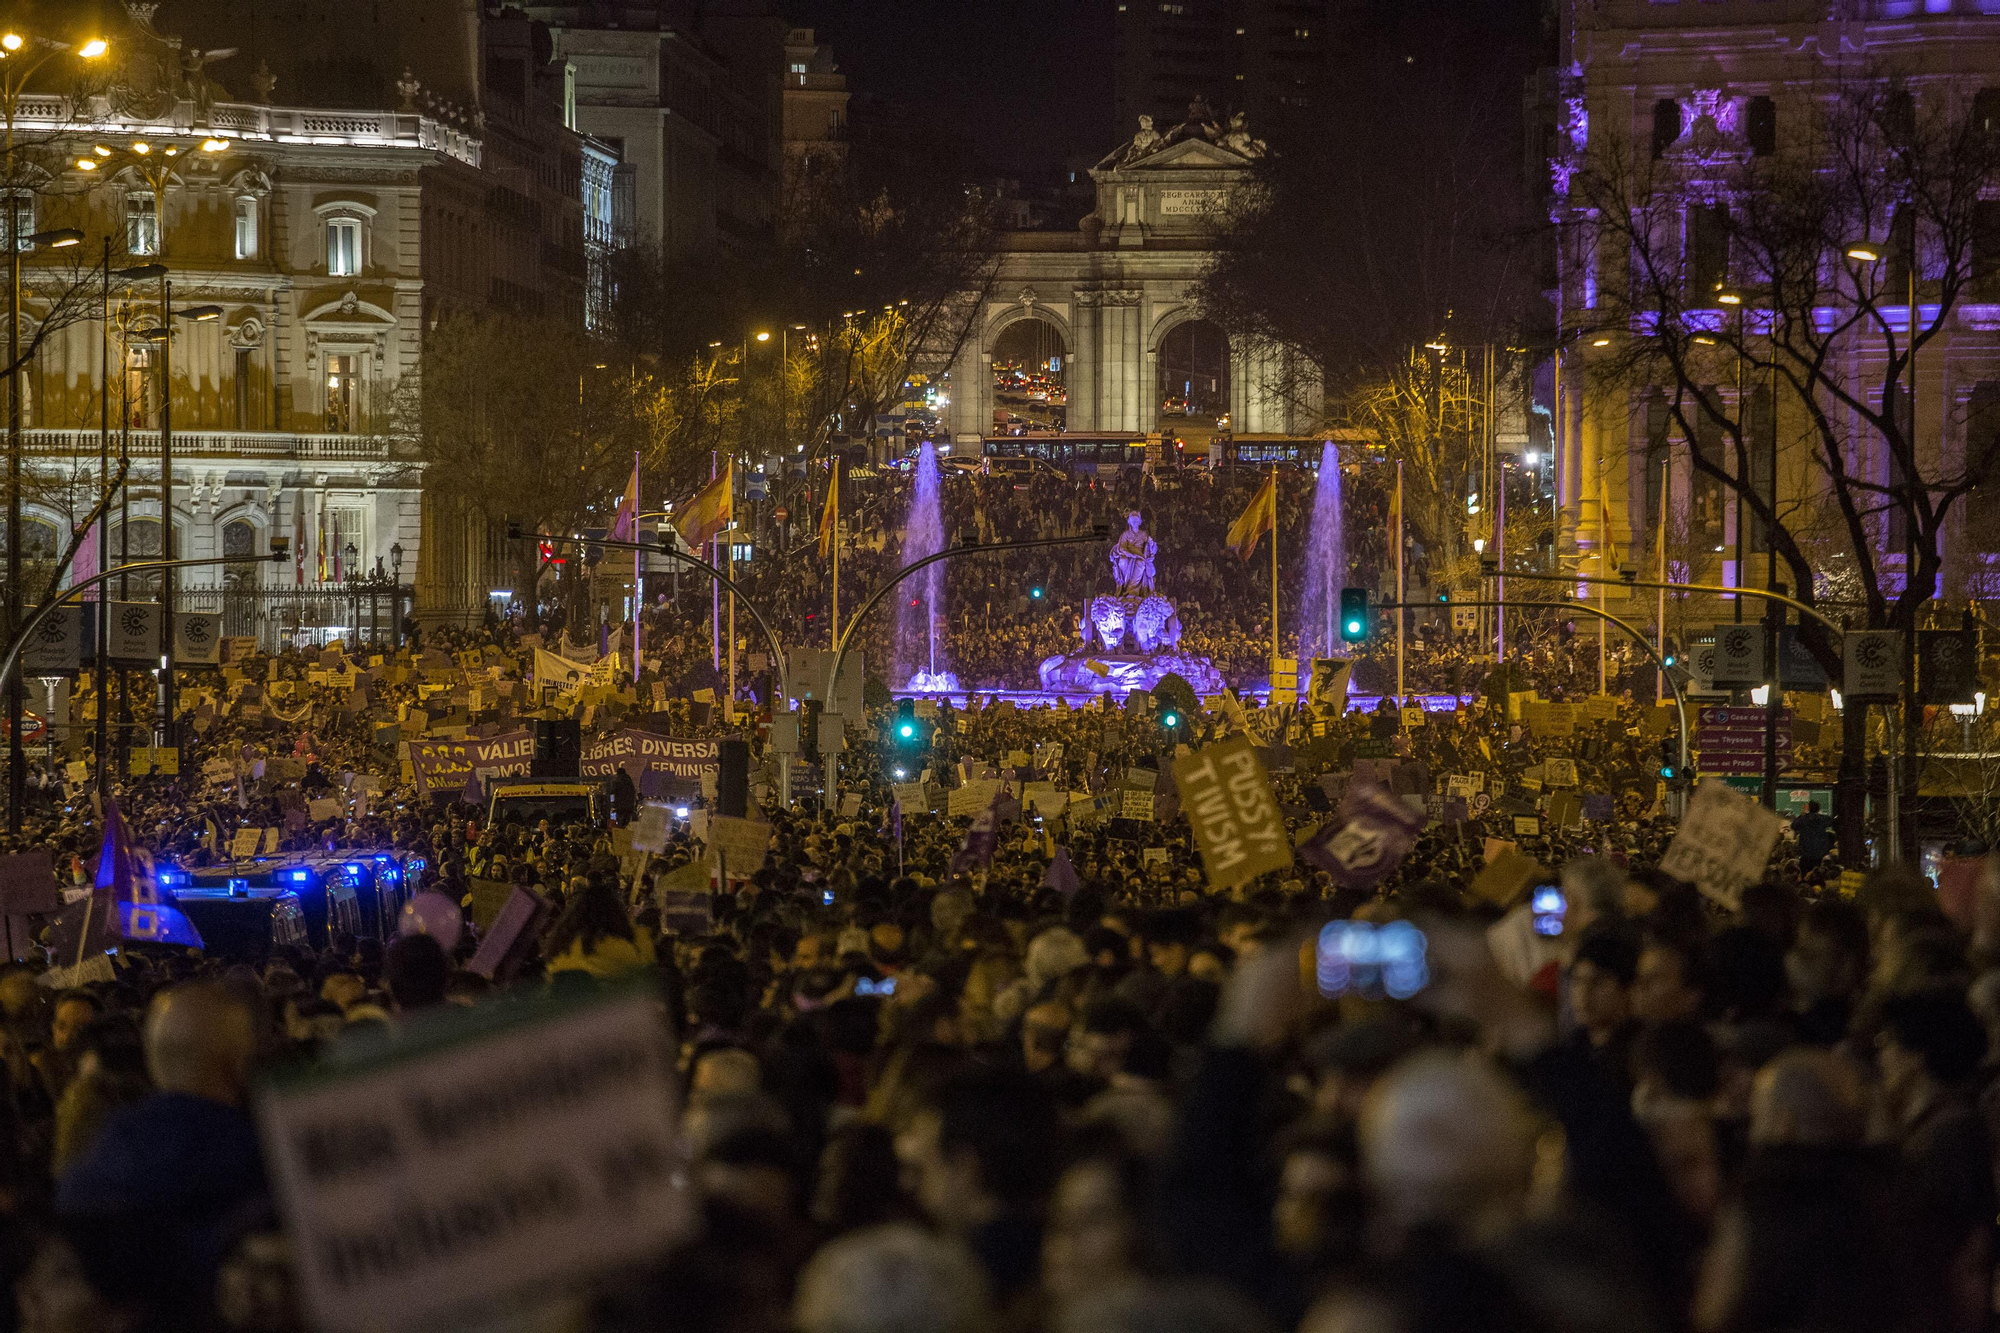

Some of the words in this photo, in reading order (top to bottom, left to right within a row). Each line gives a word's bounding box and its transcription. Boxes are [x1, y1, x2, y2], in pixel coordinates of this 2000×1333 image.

[21, 722, 39, 730] etro
[477, 739, 534, 760] VALIE
[1732, 759, 1755, 767] Prado
